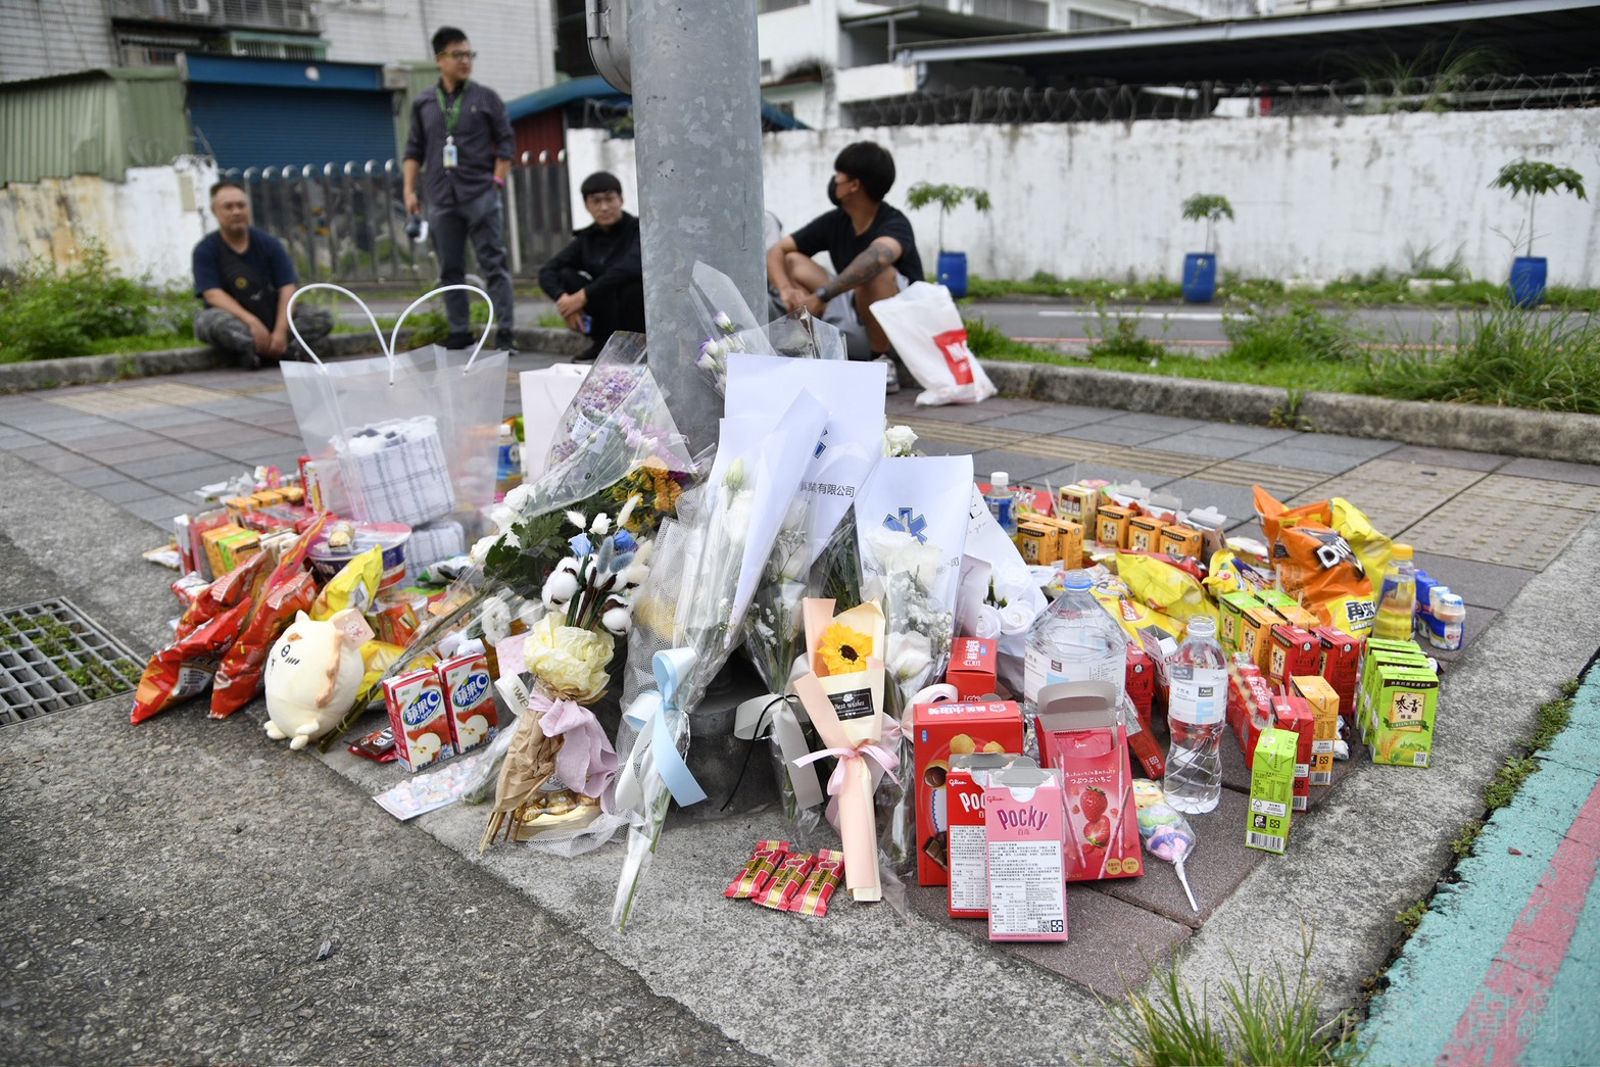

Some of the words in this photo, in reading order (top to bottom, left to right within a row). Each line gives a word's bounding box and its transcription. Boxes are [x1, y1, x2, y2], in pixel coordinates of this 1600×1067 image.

[1070, 775, 1112, 785] つぶつぶいちご
